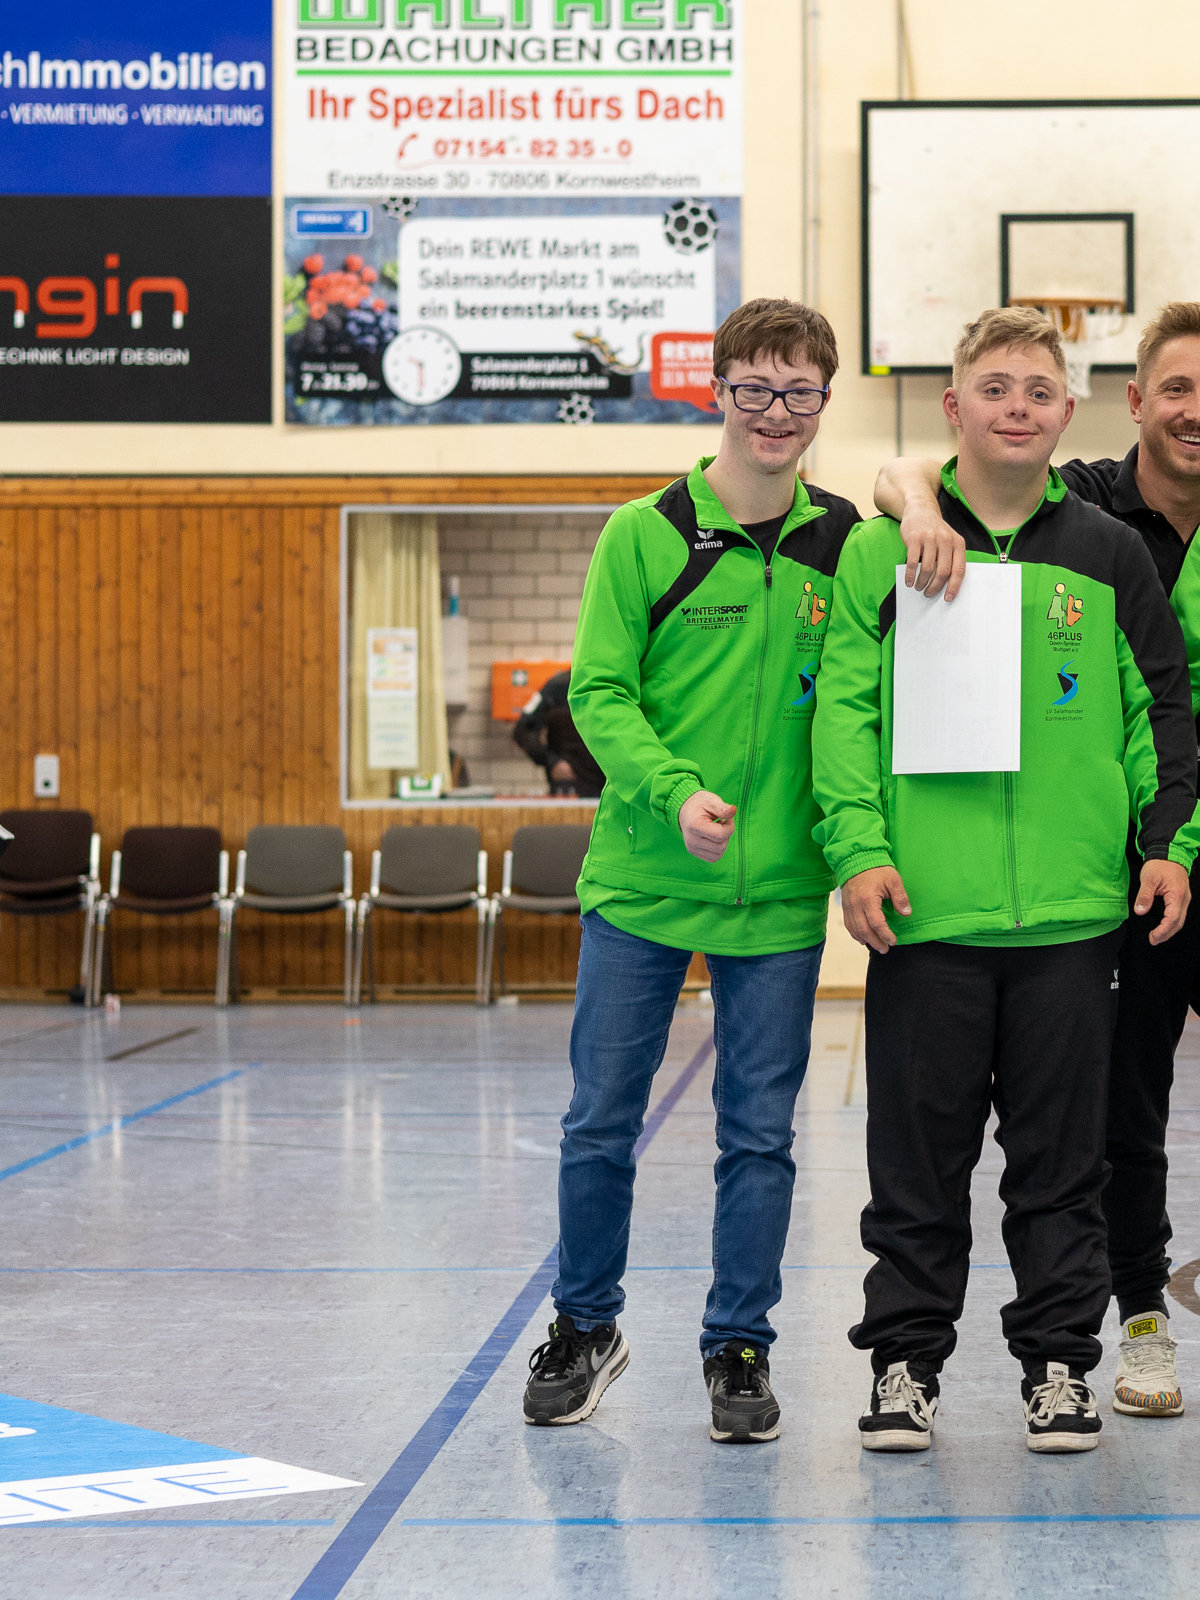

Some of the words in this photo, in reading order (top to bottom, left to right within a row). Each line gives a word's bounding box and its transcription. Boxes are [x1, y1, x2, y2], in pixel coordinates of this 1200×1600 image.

[296, 37, 602, 62] BEDACHUNGEN
[616, 37, 734, 62] GMBH
[0, 51, 266, 90] hImmobilien
[9, 103, 129, 125] VERMIETUNG
[140, 104, 264, 126] VERWALTUNG
[308, 88, 354, 120] Ihr
[368, 87, 541, 128] Spezialist
[555, 88, 622, 120] fürs
[637, 88, 725, 120] Dach
[434, 138, 507, 158] 07154
[530, 138, 558, 158] 82
[568, 138, 595, 158] 35
[617, 138, 633, 158] 0
[443, 171, 471, 189] 30
[557, 170, 701, 190] Kornwestheim
[418, 238, 464, 259] Dein
[470, 238, 532, 258] REWE
[539, 238, 602, 259] Markt
[608, 244, 640, 258] am
[418, 268, 588, 293] Salamanderplatz
[596, 269, 605, 288] 1
[609, 268, 696, 289] wünscht
[418, 300, 448, 319] ein
[454, 299, 600, 319] beerenstarkes
[606, 298, 664, 324] Spiel!
[66, 347, 119, 366] LICHT
[121, 347, 190, 366] DESIGN
[694, 540, 723, 550] erima
[686, 616, 744, 624] BRITZELMAYER
[692, 605, 748, 616] INTERSPORT
[795, 632, 825, 642] 46PLUS
[1048, 632, 1082, 641] 46PLUS
[0, 1471, 288, 1518] ITE
